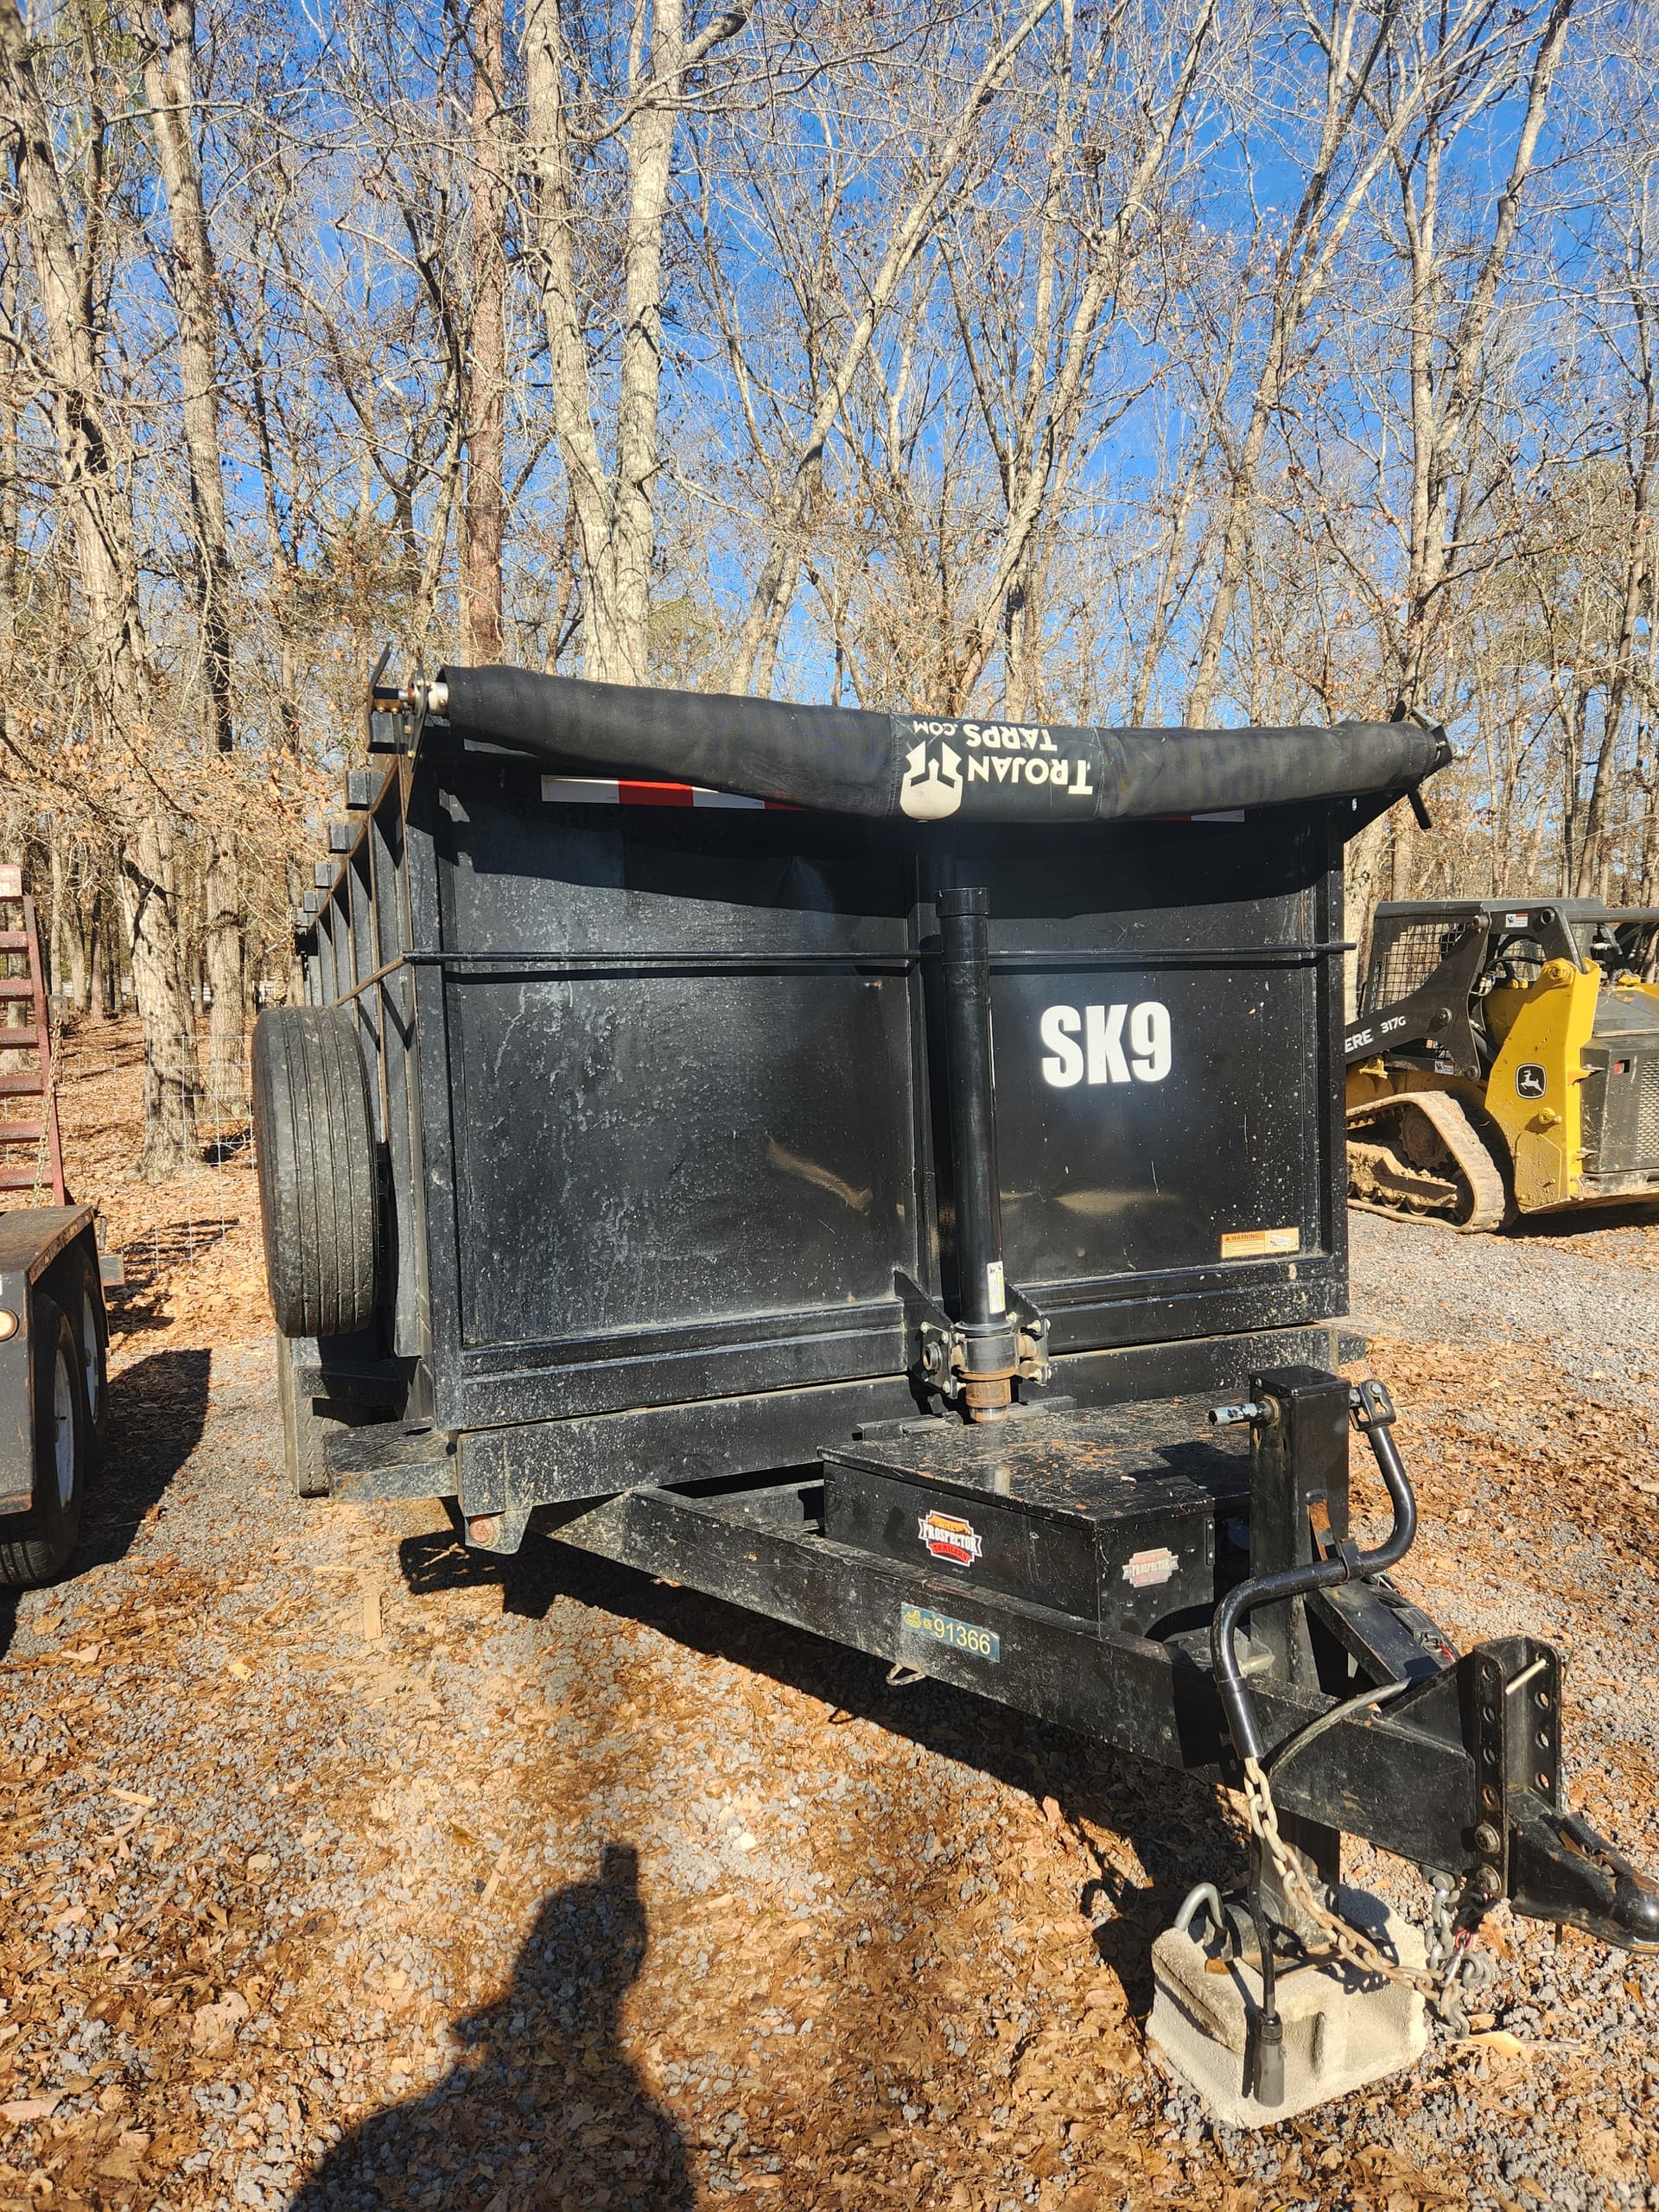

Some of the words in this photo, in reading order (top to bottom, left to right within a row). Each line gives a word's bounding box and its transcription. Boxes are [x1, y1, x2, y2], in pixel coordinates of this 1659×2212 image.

[968, 754, 1093, 795] TROJAN
[1040, 1001, 1173, 1088] SK9
[1344, 1028, 1374, 1053] ERE
[1380, 1015, 1407, 1033] 317G
[1231, 1232, 1259, 1241] WARNING
[922, 1522, 978, 1554] PROSPECTOR
[933, 1618, 991, 1656] 91366
